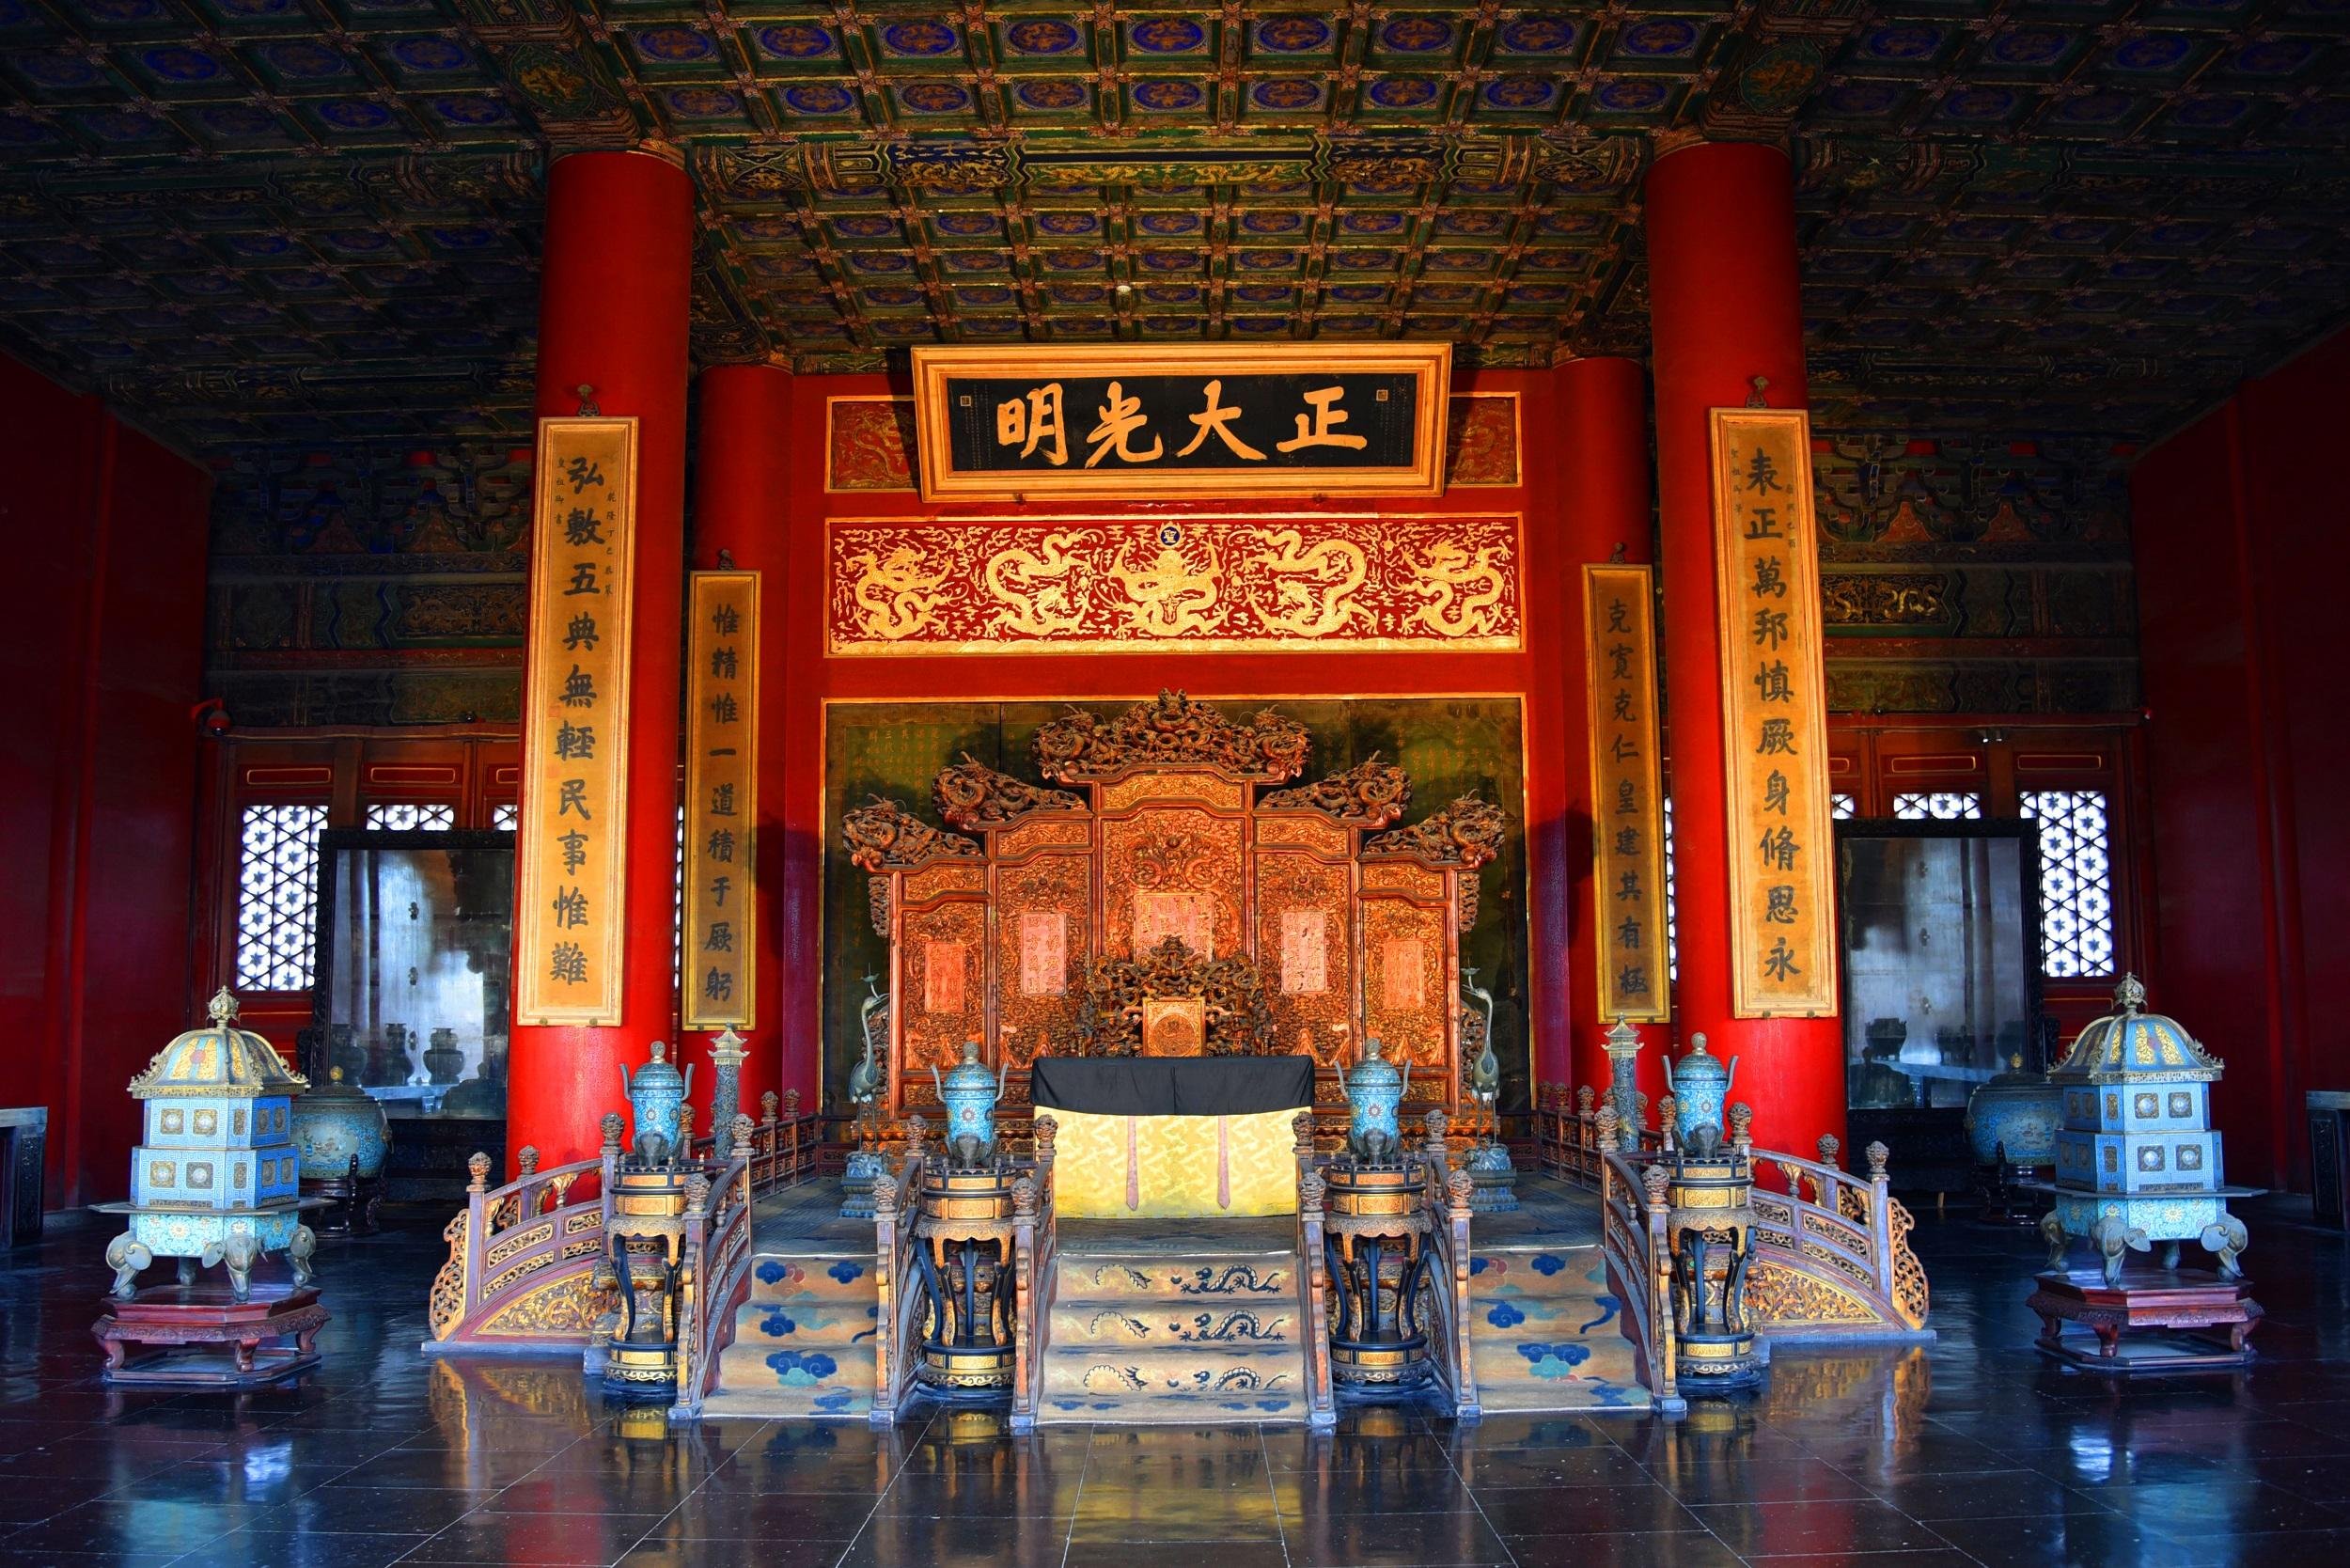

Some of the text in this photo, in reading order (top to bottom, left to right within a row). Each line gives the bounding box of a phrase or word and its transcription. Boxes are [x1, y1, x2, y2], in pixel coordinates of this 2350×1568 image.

[996, 379, 1368, 468] 正大光明
[550, 457, 604, 985] 弘敷五典無輕民事惟難
[1606, 599, 1647, 994] 克寬克仁皇建其有極
